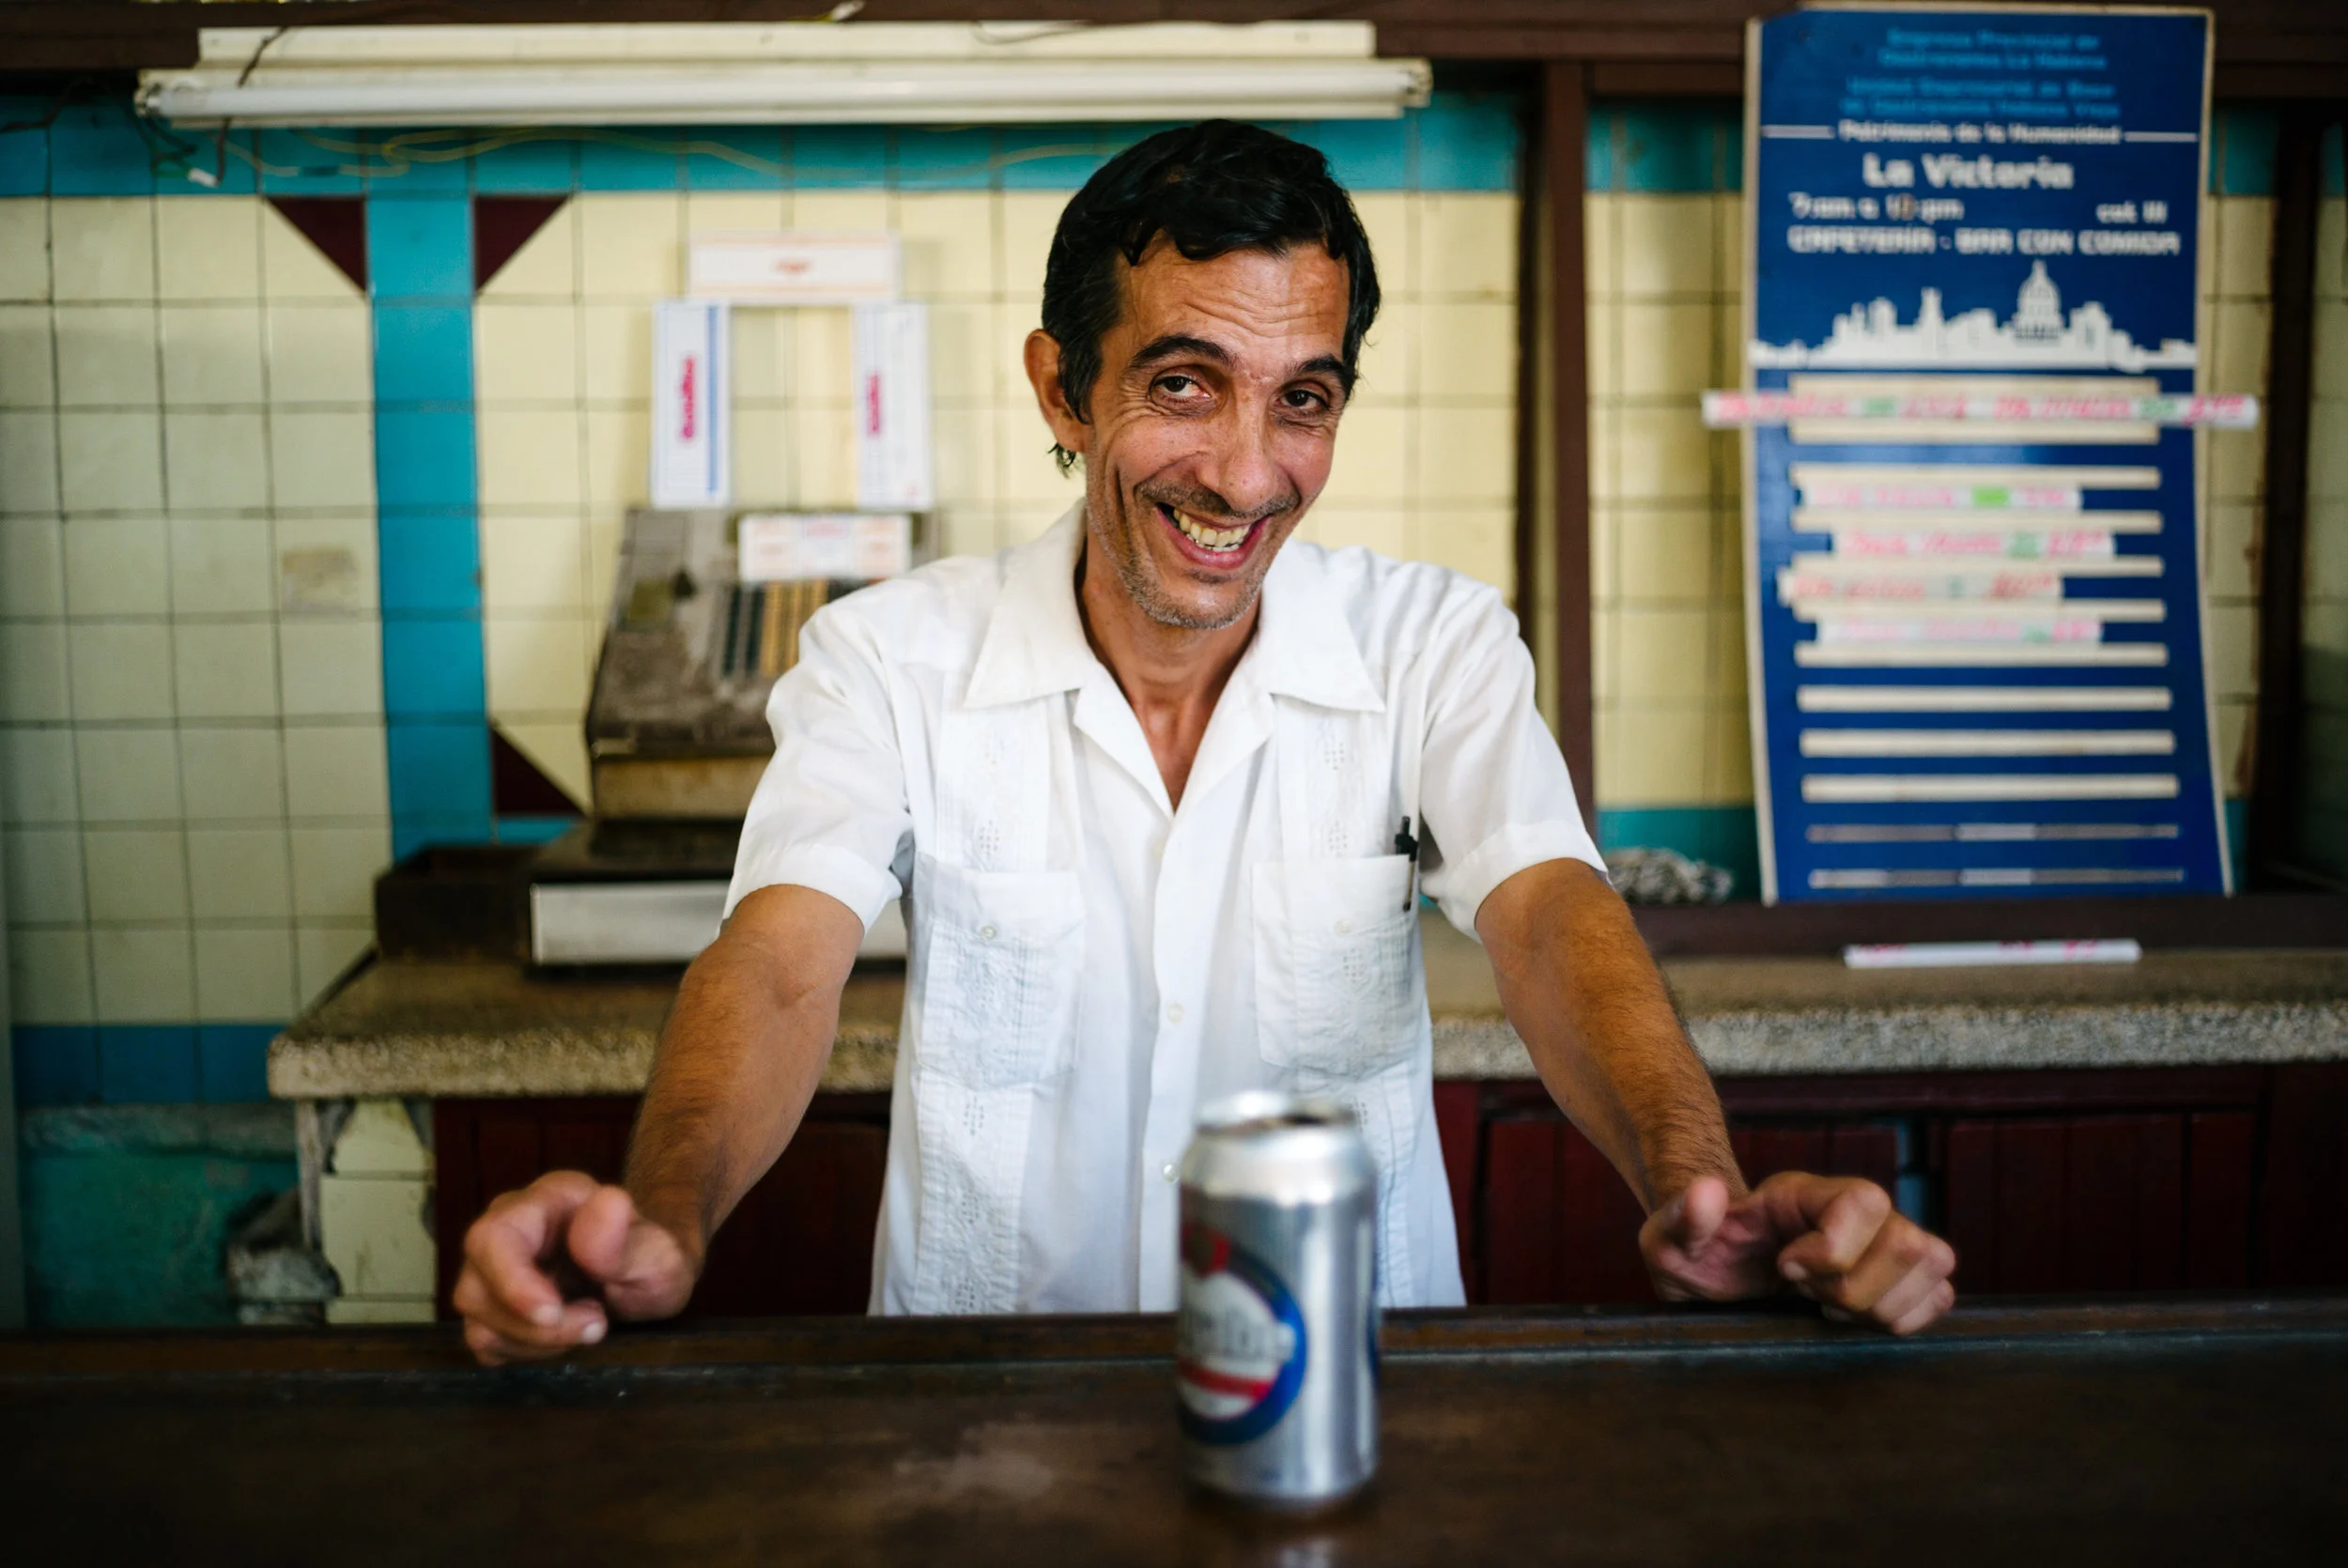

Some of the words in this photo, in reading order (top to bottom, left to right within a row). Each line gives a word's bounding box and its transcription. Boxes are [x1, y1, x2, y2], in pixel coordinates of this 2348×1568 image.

[1954, 122, 1982, 142] de
[1862, 152, 1914, 188] La
[1922, 153, 2074, 188] Victoria
[1954, 227, 2014, 254] BAR
[2016, 228, 2074, 254] CON
[2078, 229, 2181, 255] COMIDA
